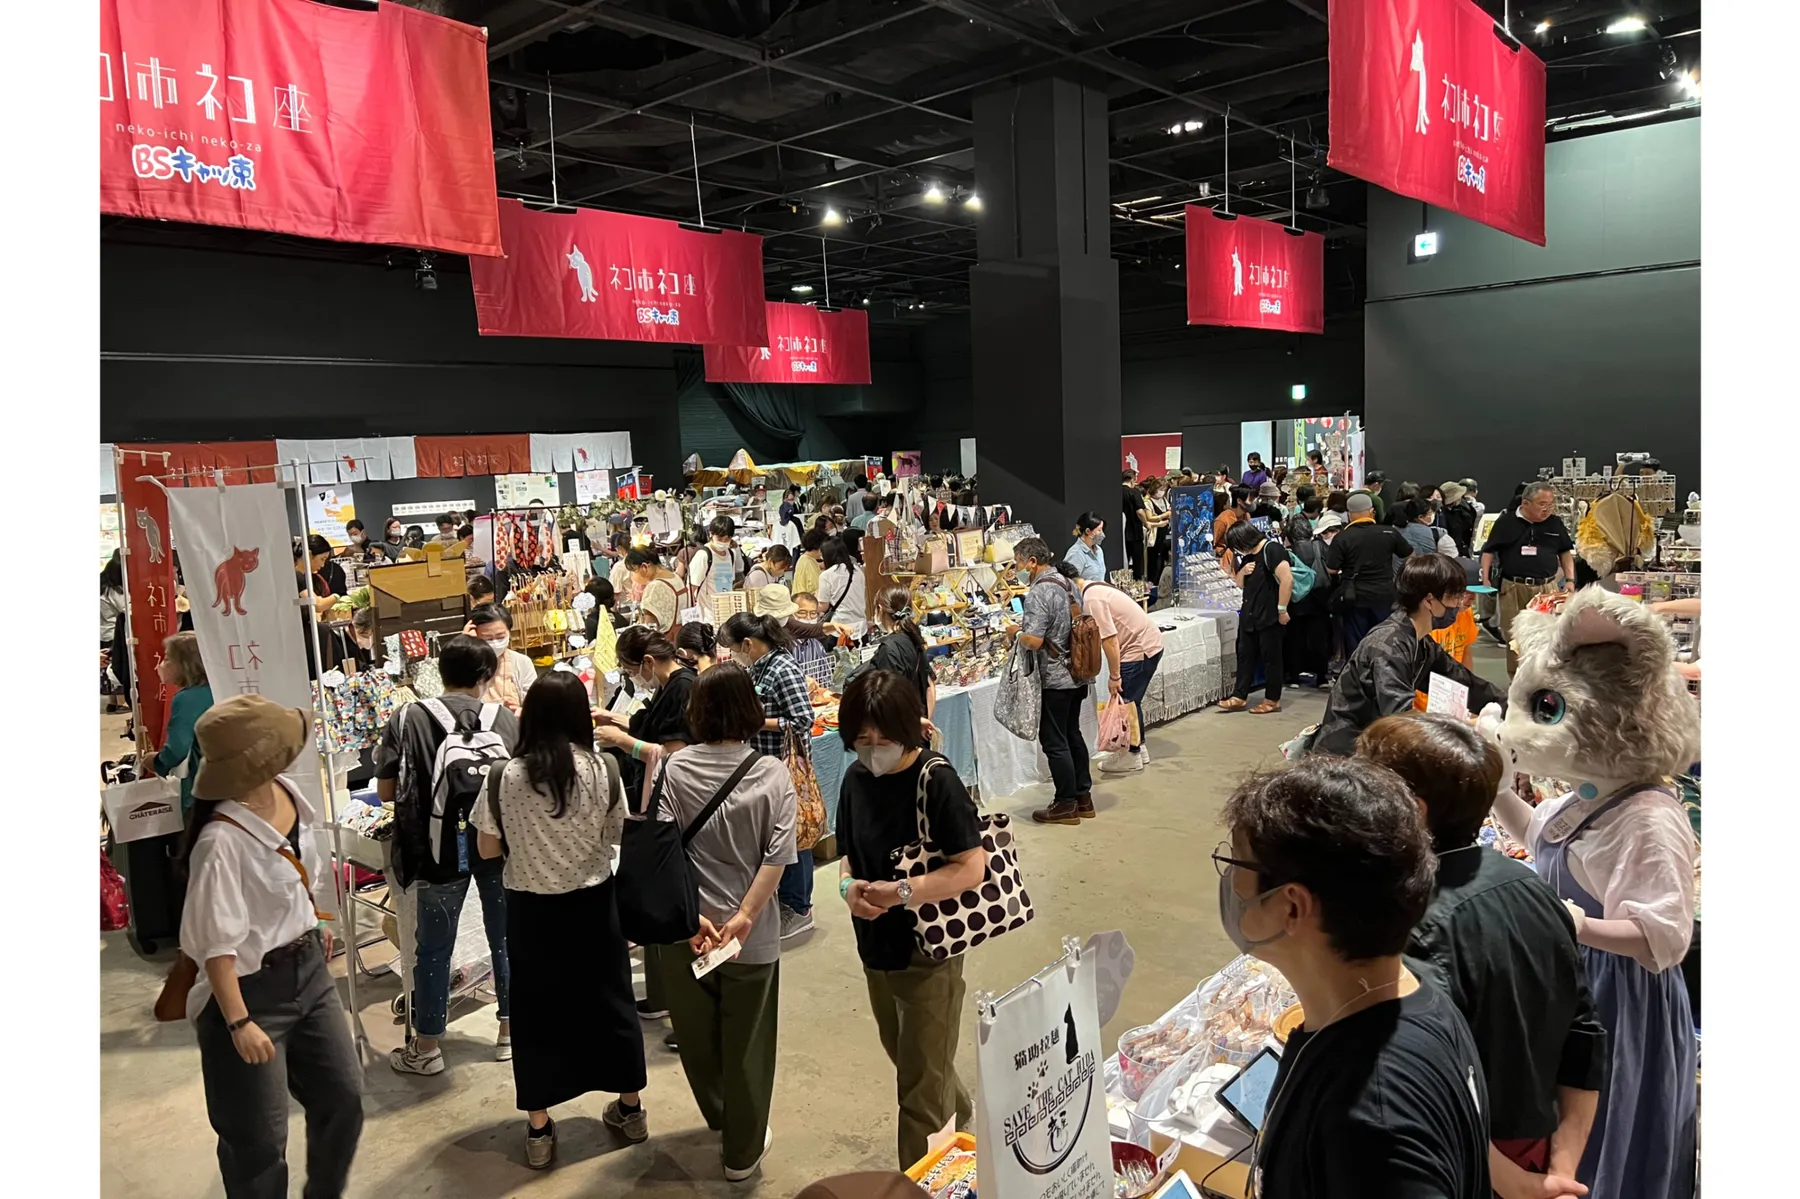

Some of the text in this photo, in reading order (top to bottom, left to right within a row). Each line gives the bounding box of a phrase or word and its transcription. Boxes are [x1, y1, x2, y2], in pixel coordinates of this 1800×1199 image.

[116, 123, 263, 154] neko-ichi neko-za
[1003, 1103, 1032, 1134] SAVE
[1036, 1085, 1055, 1110] THE
[1057, 1067, 1074, 1093] CAT
[1076, 1048, 1096, 1075] HIDA
